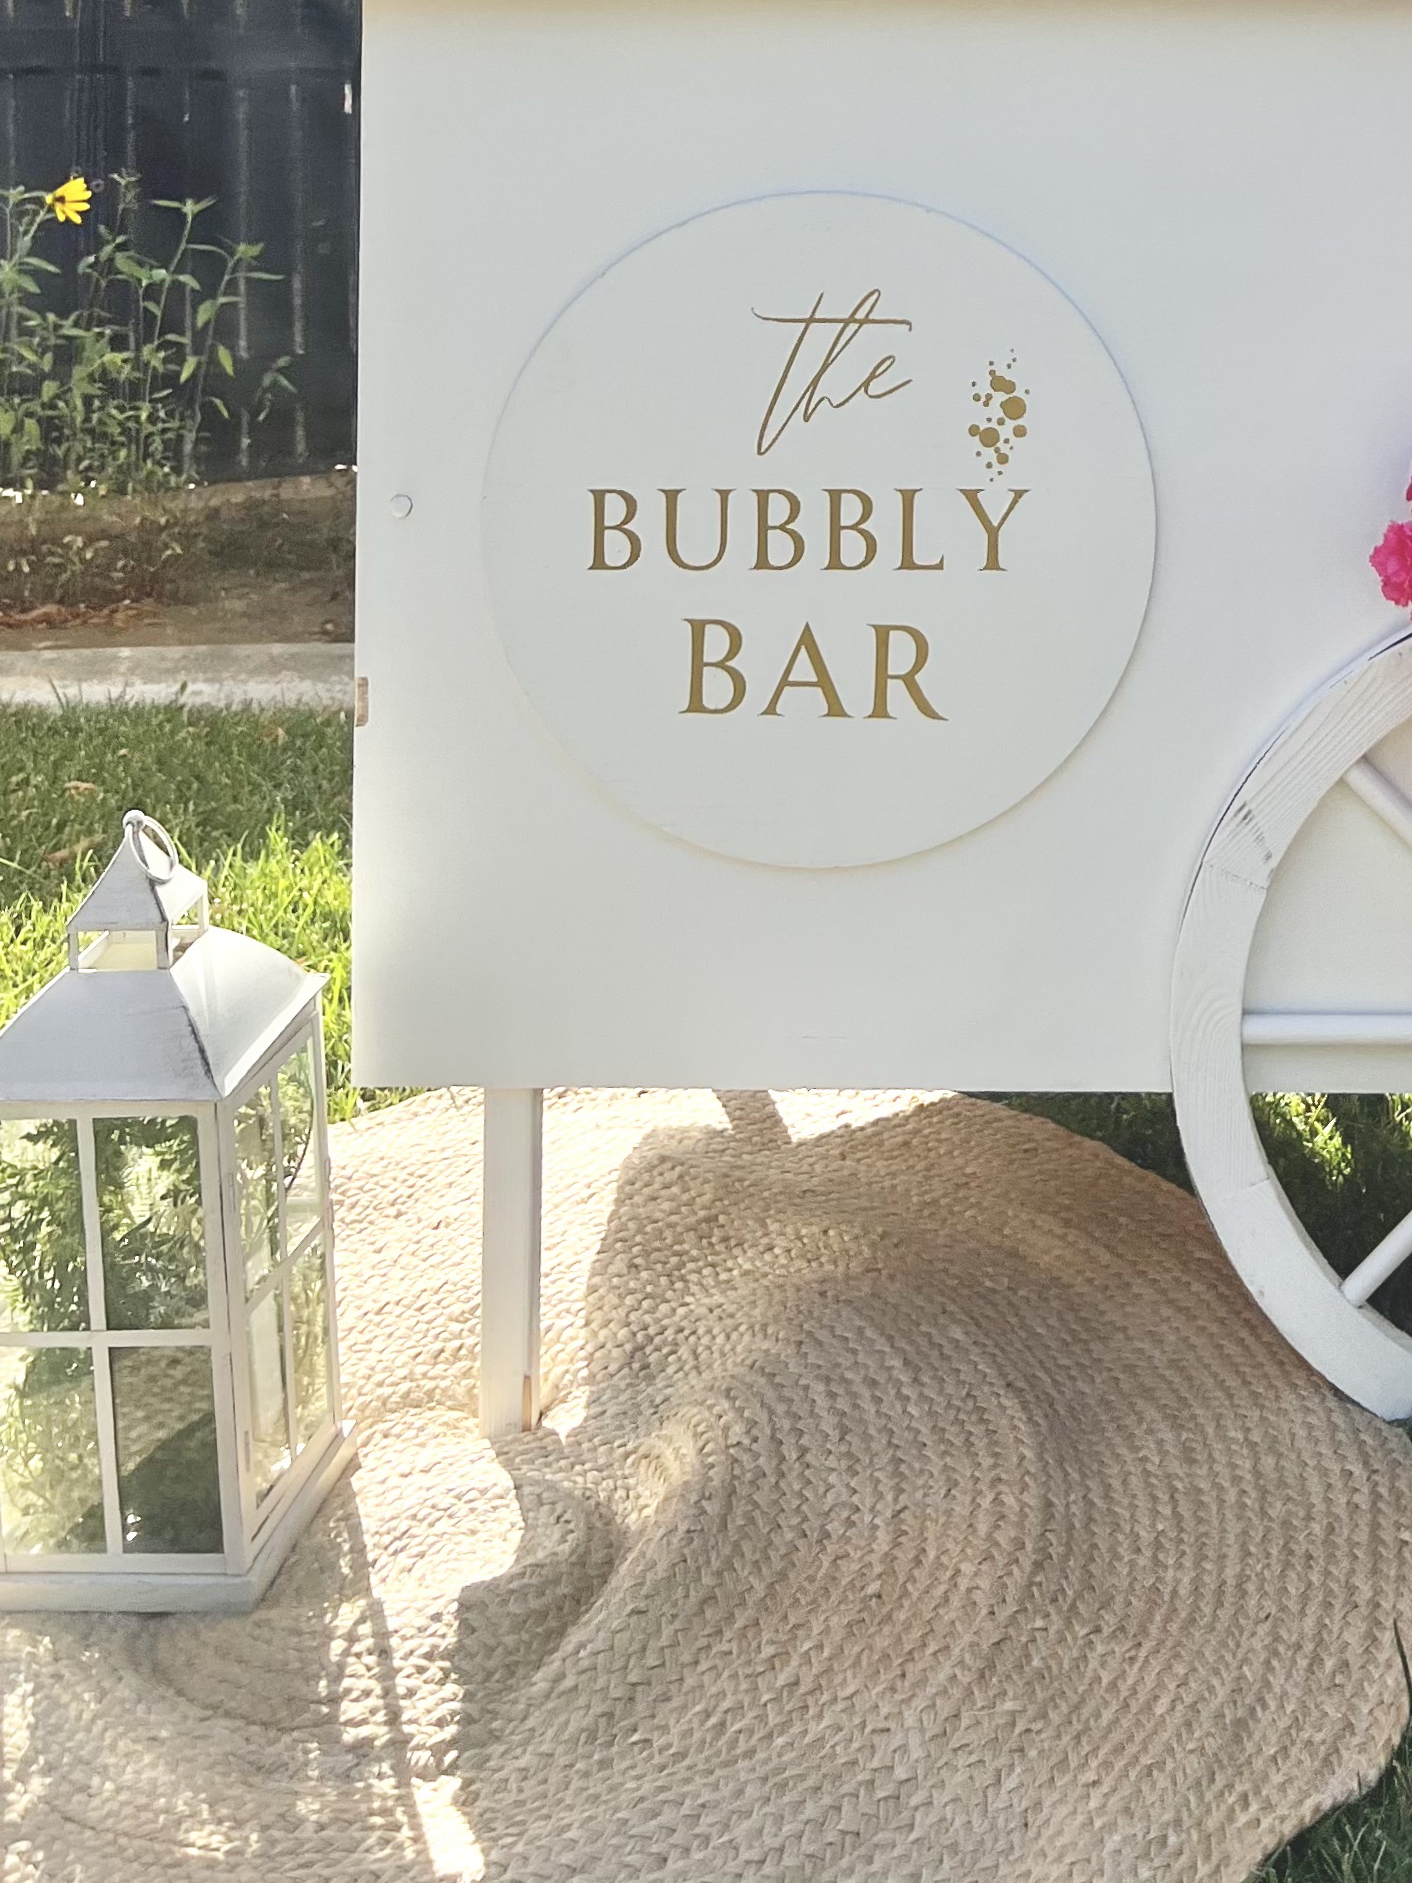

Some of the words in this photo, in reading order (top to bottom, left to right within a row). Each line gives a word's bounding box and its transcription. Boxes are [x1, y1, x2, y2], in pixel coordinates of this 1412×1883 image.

[751, 288, 913, 456] the
[586, 487, 1031, 572] BUBBLY
[677, 617, 950, 722] BAR
